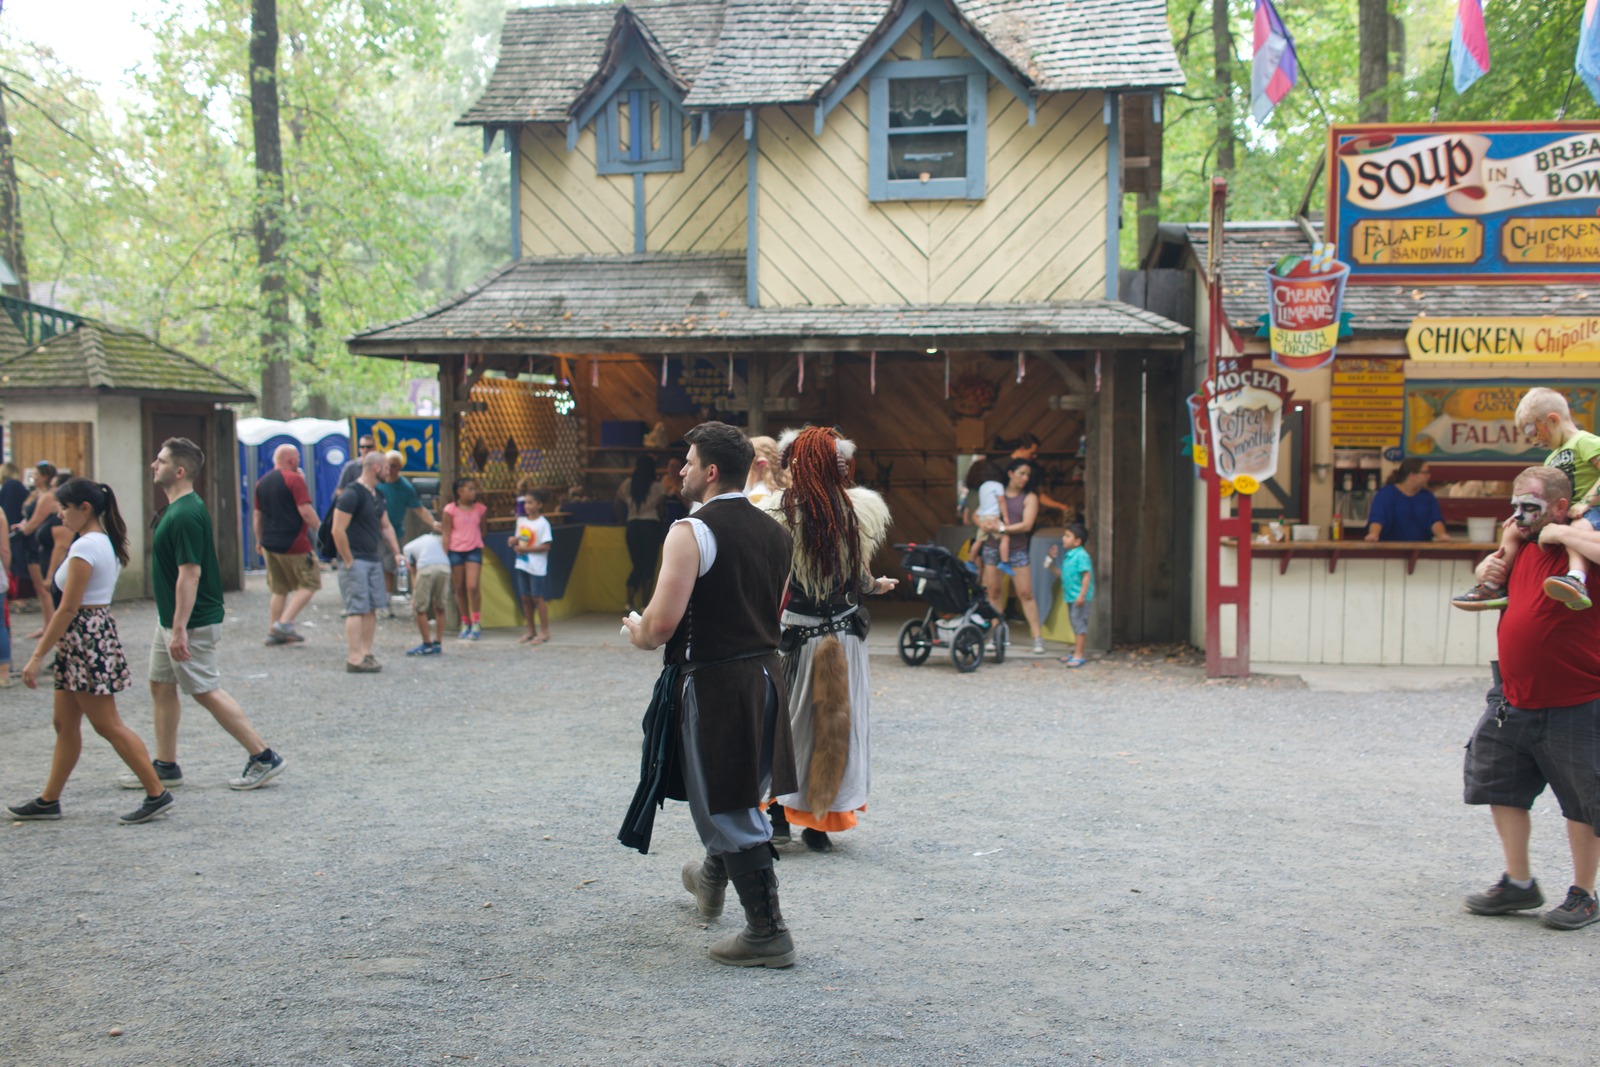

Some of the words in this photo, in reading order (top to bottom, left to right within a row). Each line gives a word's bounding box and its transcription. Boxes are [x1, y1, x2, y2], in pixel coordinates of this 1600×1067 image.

[1488, 167, 1508, 181] IN
[1363, 222, 1451, 255] FALAFEL
[1510, 223, 1600, 249] CHICKEN
[1391, 247, 1465, 261] SANDWICH
[1274, 285, 1336, 306] CHERRY
[1278, 303, 1333, 327] LIMEADE
[1275, 329, 1327, 343] SLUSH
[1283, 341, 1330, 355] DRINK
[1418, 326, 1525, 354] CHICKEN
[1534, 318, 1600, 358] Chipotle
[1206, 371, 1281, 396] MOCHA
[1218, 406, 1263, 440] Coffee
[371, 420, 440, 470] Pri
[1219, 431, 1276, 475] Smoothie
